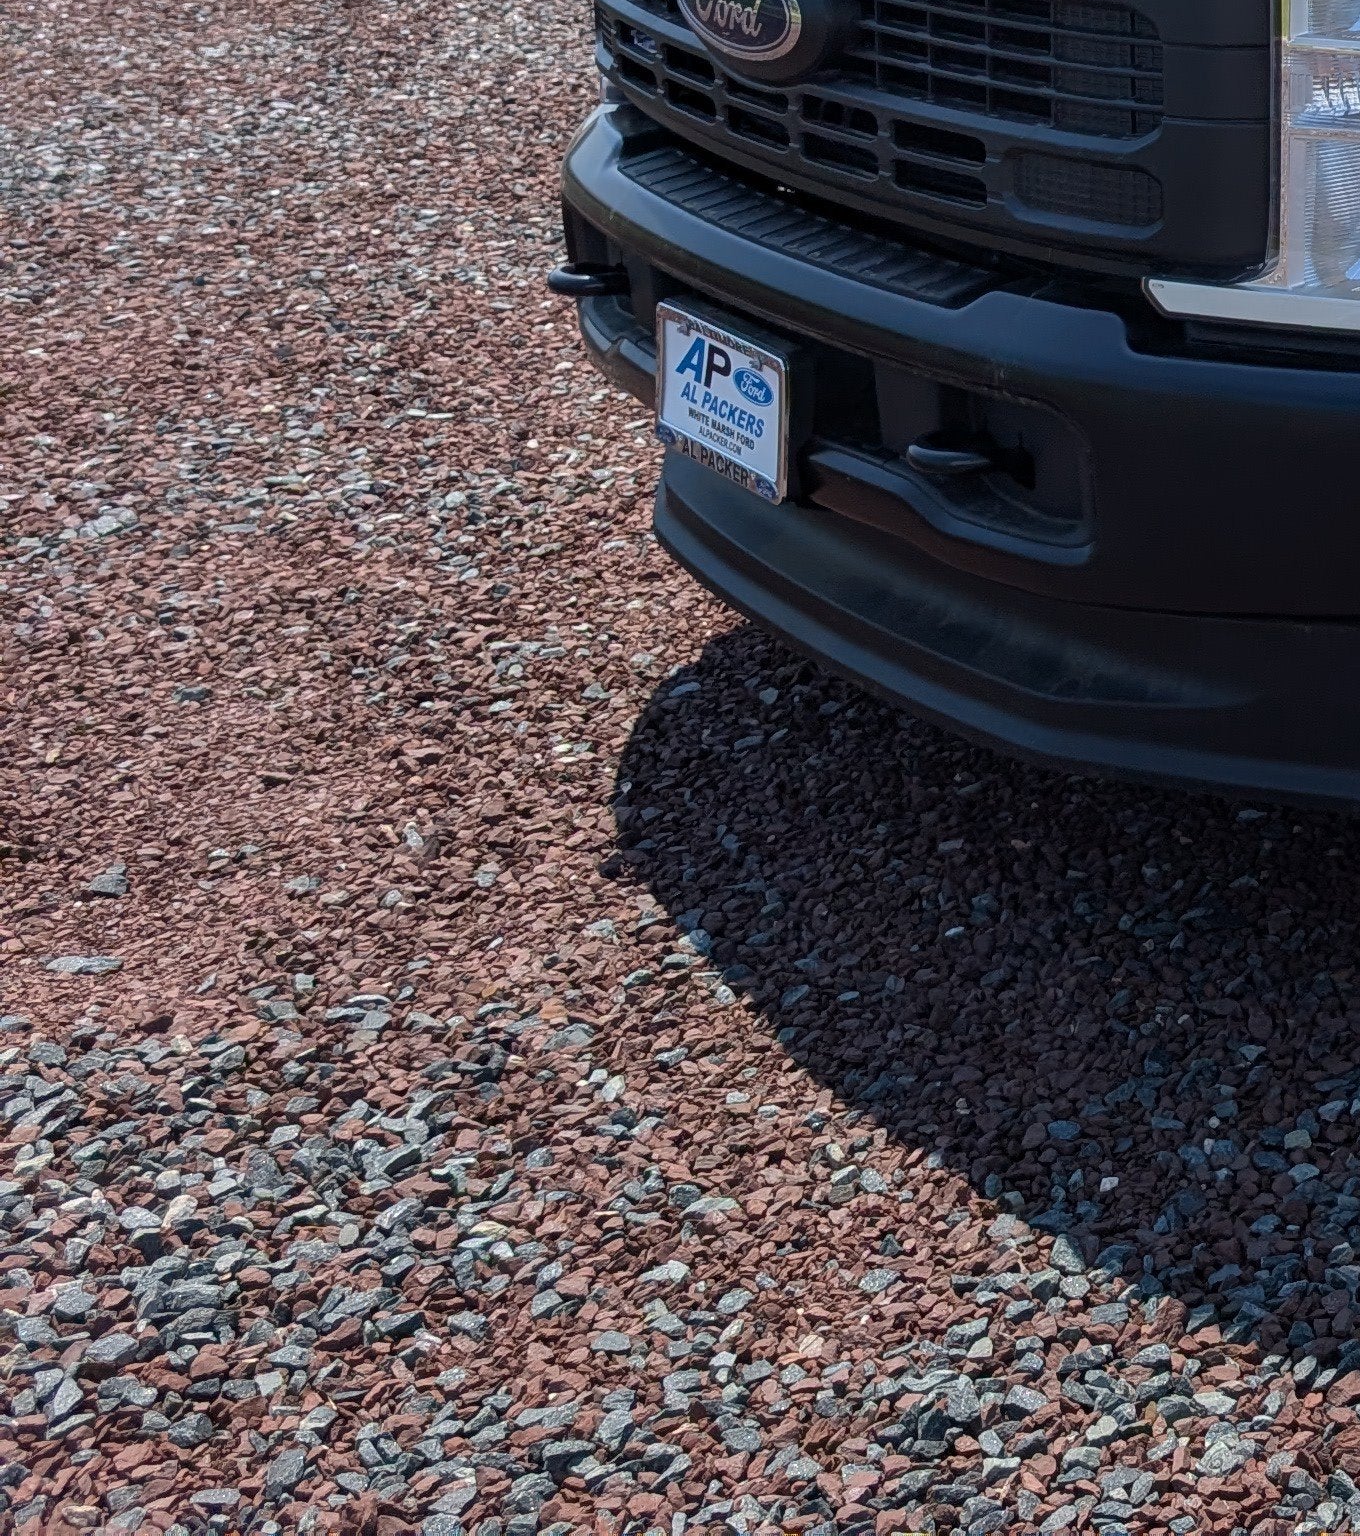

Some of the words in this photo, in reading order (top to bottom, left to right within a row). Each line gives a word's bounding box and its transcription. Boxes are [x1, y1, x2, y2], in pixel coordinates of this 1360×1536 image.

[675, 336, 732, 390] AP
[680, 381, 698, 405] AL
[701, 390, 765, 439] PACKERS
[740, 372, 767, 403] Ford
[688, 407, 710, 428] WHITE
[711, 417, 735, 440] MARSH
[736, 432, 755, 451] FORD
[698, 425, 742, 456] ALPACKER.COM
[681, 437, 698, 460] AL
[700, 447, 749, 488] PACKER
